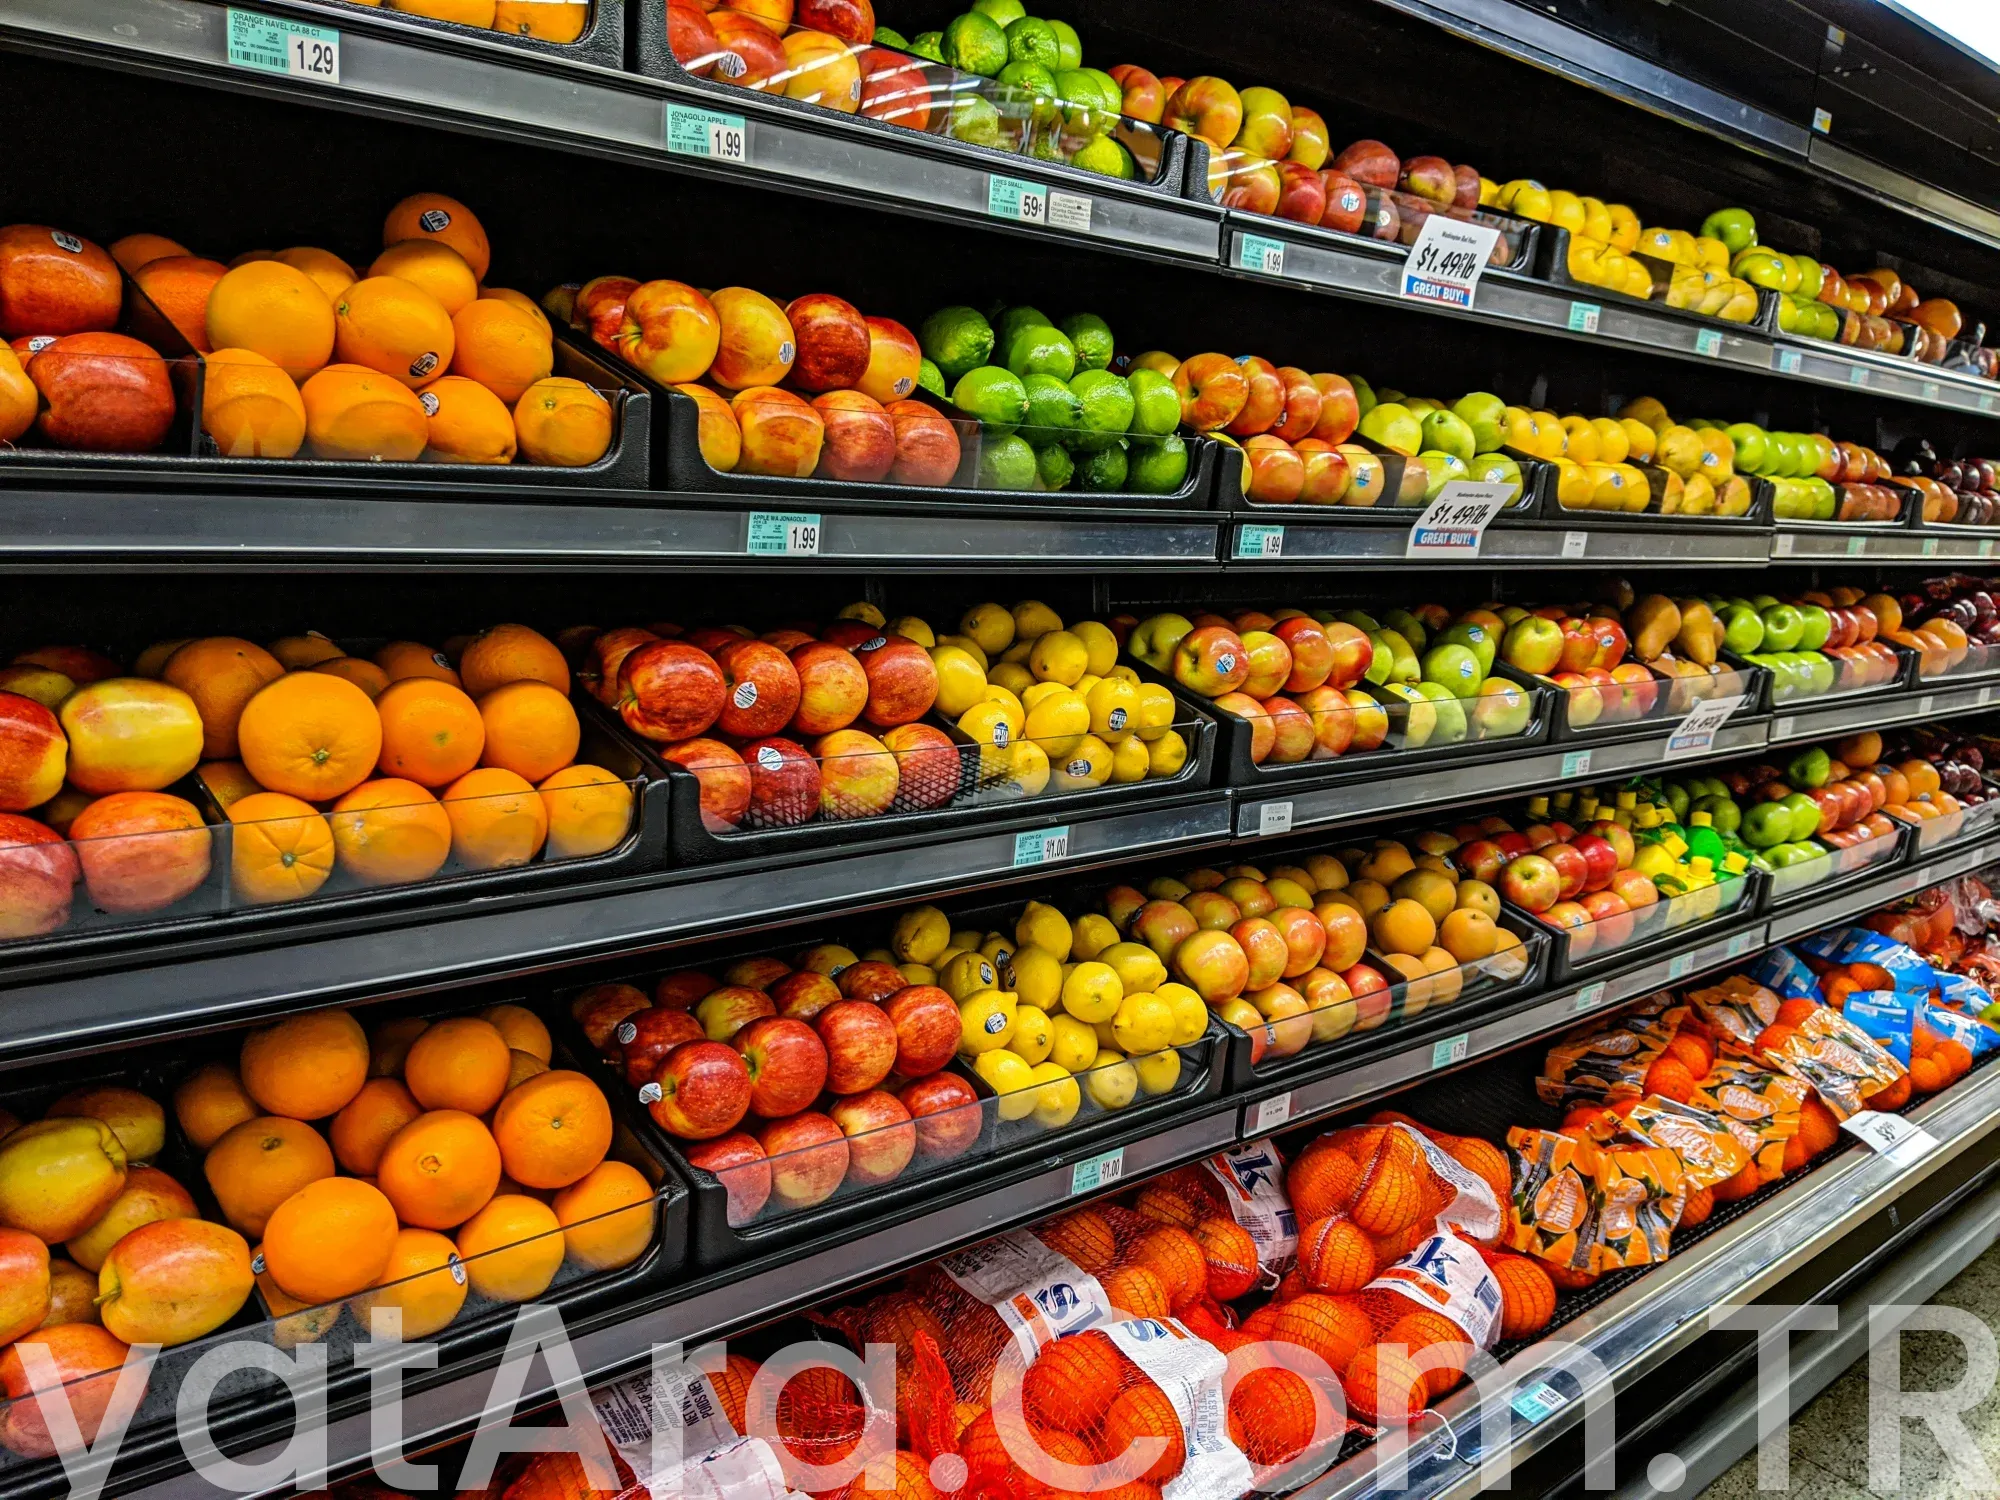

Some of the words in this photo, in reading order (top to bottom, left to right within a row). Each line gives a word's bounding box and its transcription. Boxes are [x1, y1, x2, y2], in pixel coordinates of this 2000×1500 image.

[233, 13, 264, 25] ORANGE
[266, 19, 288, 30] NAVEL
[290, 25, 300, 33] CA
[311, 29, 320, 37] CT
[297, 41, 334, 74] 1.29
[671, 111, 706, 122] JONAGOLD
[707, 116, 727, 125] APPLE
[716, 130, 740, 157] 1.99
[1267, 252, 1281, 272] 1.99
[1417, 243, 1462, 276] $1.49
[1413, 282, 1441, 297] GREAT
[1443, 286, 1464, 302] BUY!
[1428, 503, 1474, 525] $1.49
[793, 527, 815, 549] 1.99
[1266, 536, 1280, 553] 1.99
[1421, 532, 1449, 544] GREAT
[1450, 533, 1471, 544] BUY!
[688, 1380, 704, 1397] NET
[694, 1394, 714, 1420] POIDS
[1208, 1400, 1218, 1417] 3.63
[682, 1410, 700, 1426] NET
[1207, 1420, 1217, 1433] NET
